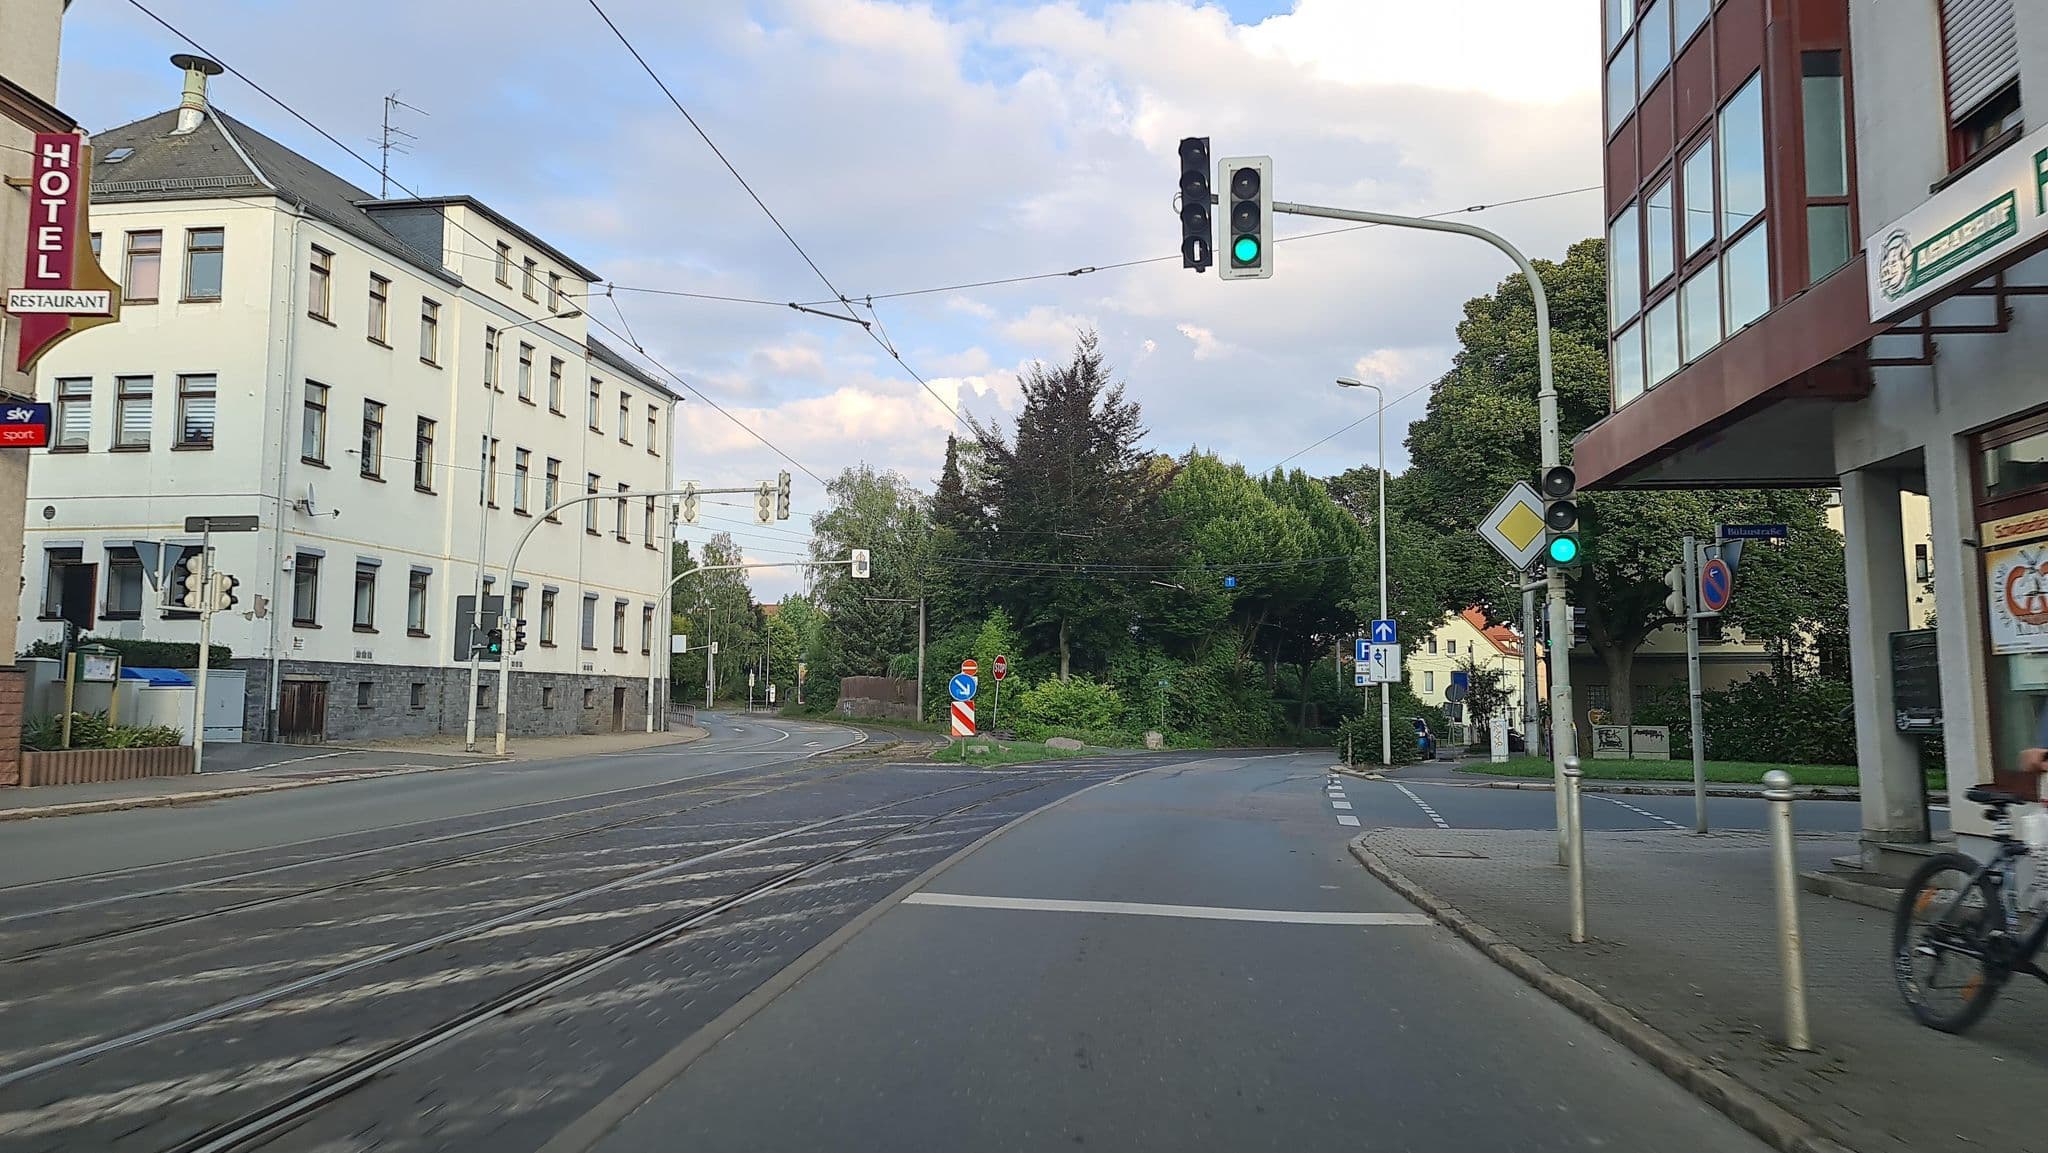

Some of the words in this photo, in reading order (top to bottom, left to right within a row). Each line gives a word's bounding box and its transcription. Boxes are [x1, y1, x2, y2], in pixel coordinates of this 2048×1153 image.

[37, 143, 71, 279] HOTEL
[9, 294, 107, 310] RESTAURANT
[6, 407, 35, 423] sky
[3, 430, 36, 441] sport
[994, 662, 1006, 674] STOP
